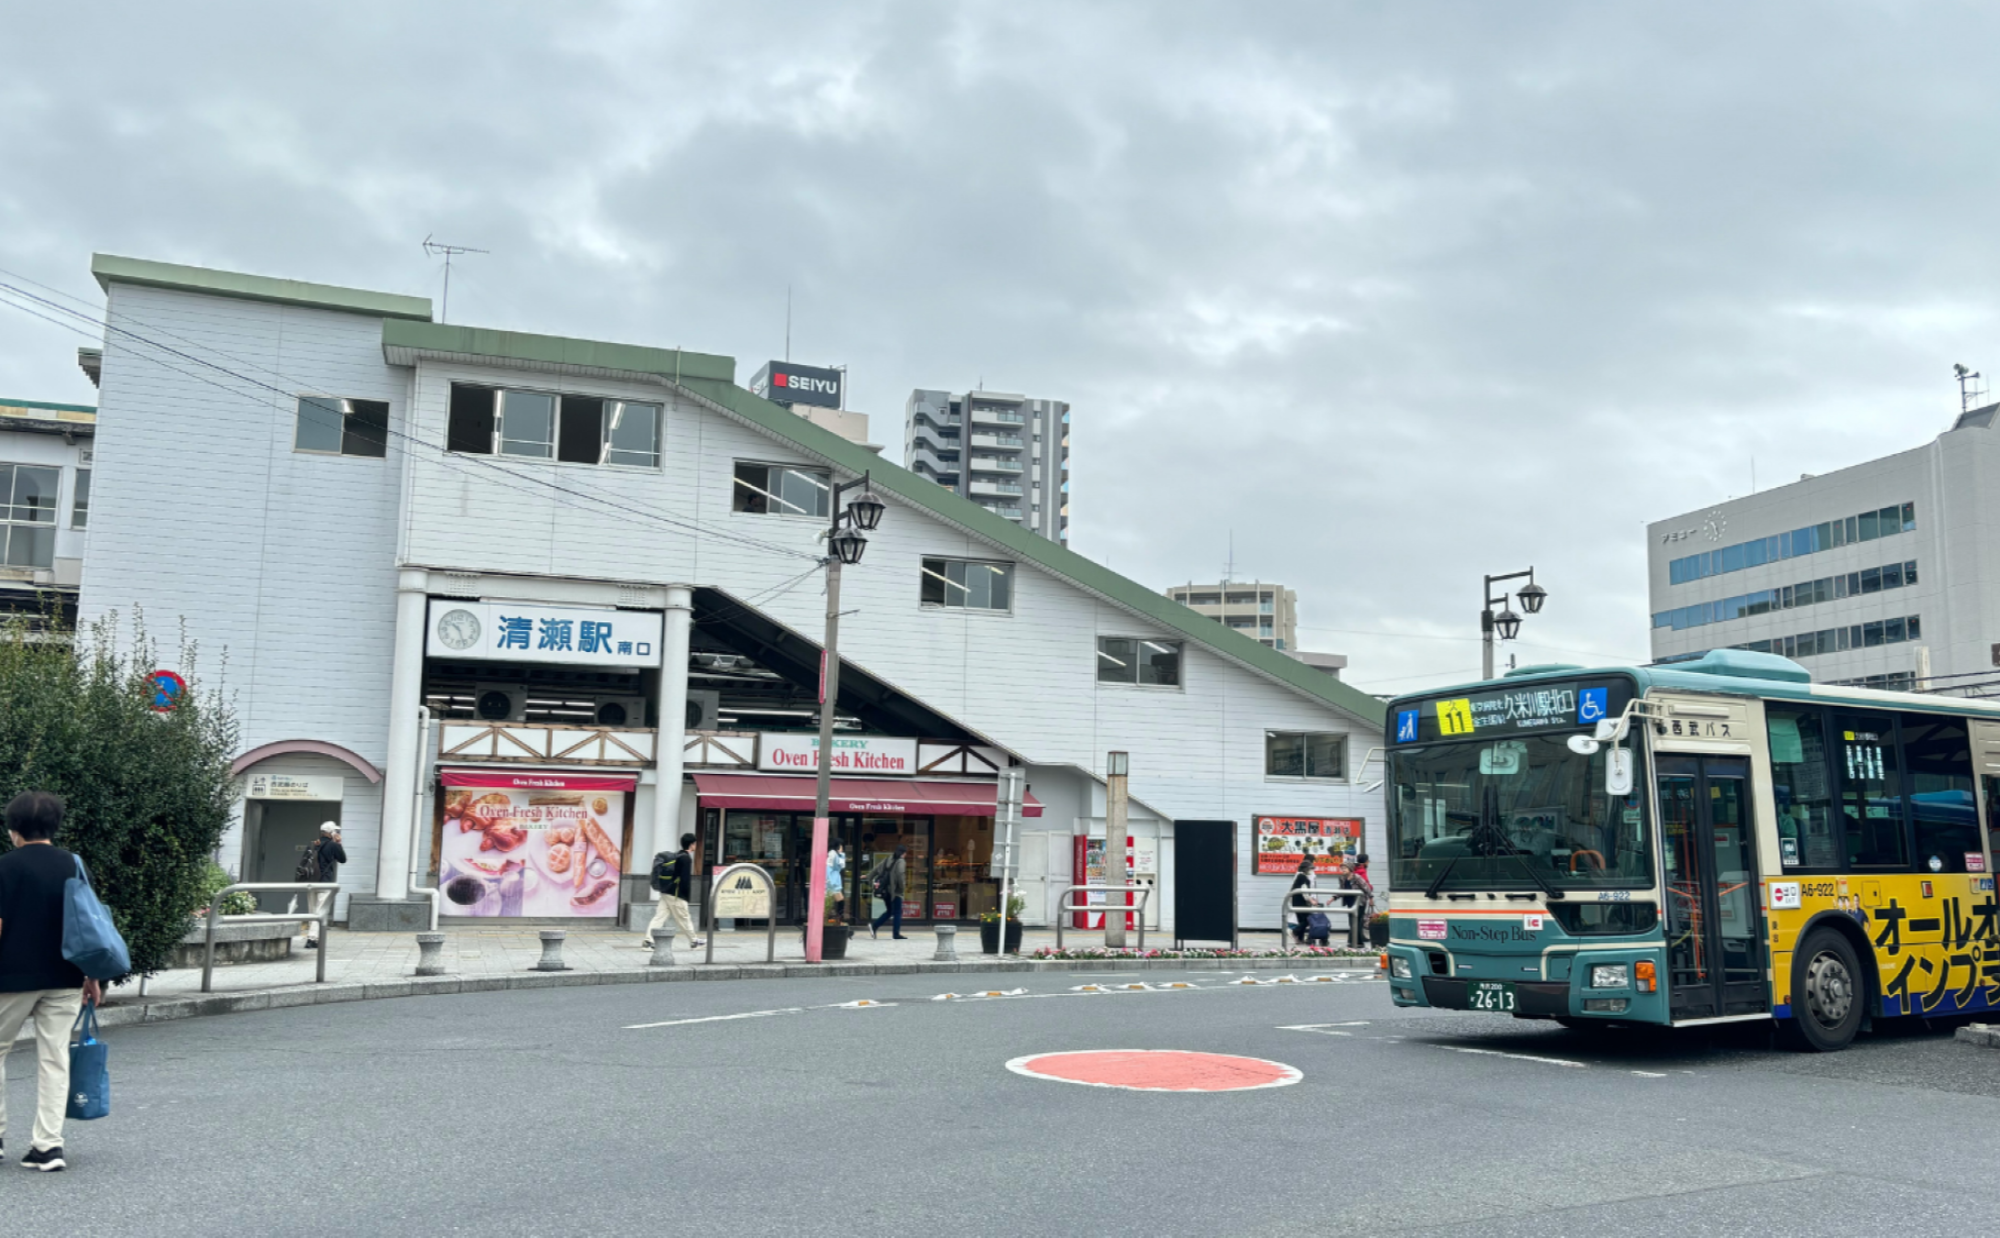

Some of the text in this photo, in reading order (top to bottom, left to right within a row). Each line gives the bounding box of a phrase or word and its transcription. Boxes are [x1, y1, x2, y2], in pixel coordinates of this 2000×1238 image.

[788, 375, 837, 394] SEIYU
[497, 615, 613, 654] 清瀬駅
[616, 640, 650, 656] 南口
[1504, 689, 1576, 719] 久米川駅北口
[1445, 711, 1466, 733] 11
[1671, 720, 1731, 737] 西武バス
[811, 738, 869, 749] BKERY
[772, 748, 904, 769] Oven Fesh Kitchen
[1801, 883, 1835, 897] A6-922
[1451, 925, 1509, 943] Non-Step
[1511, 925, 1537, 942] Bus
[1475, 990, 1515, 1010] 26-13
